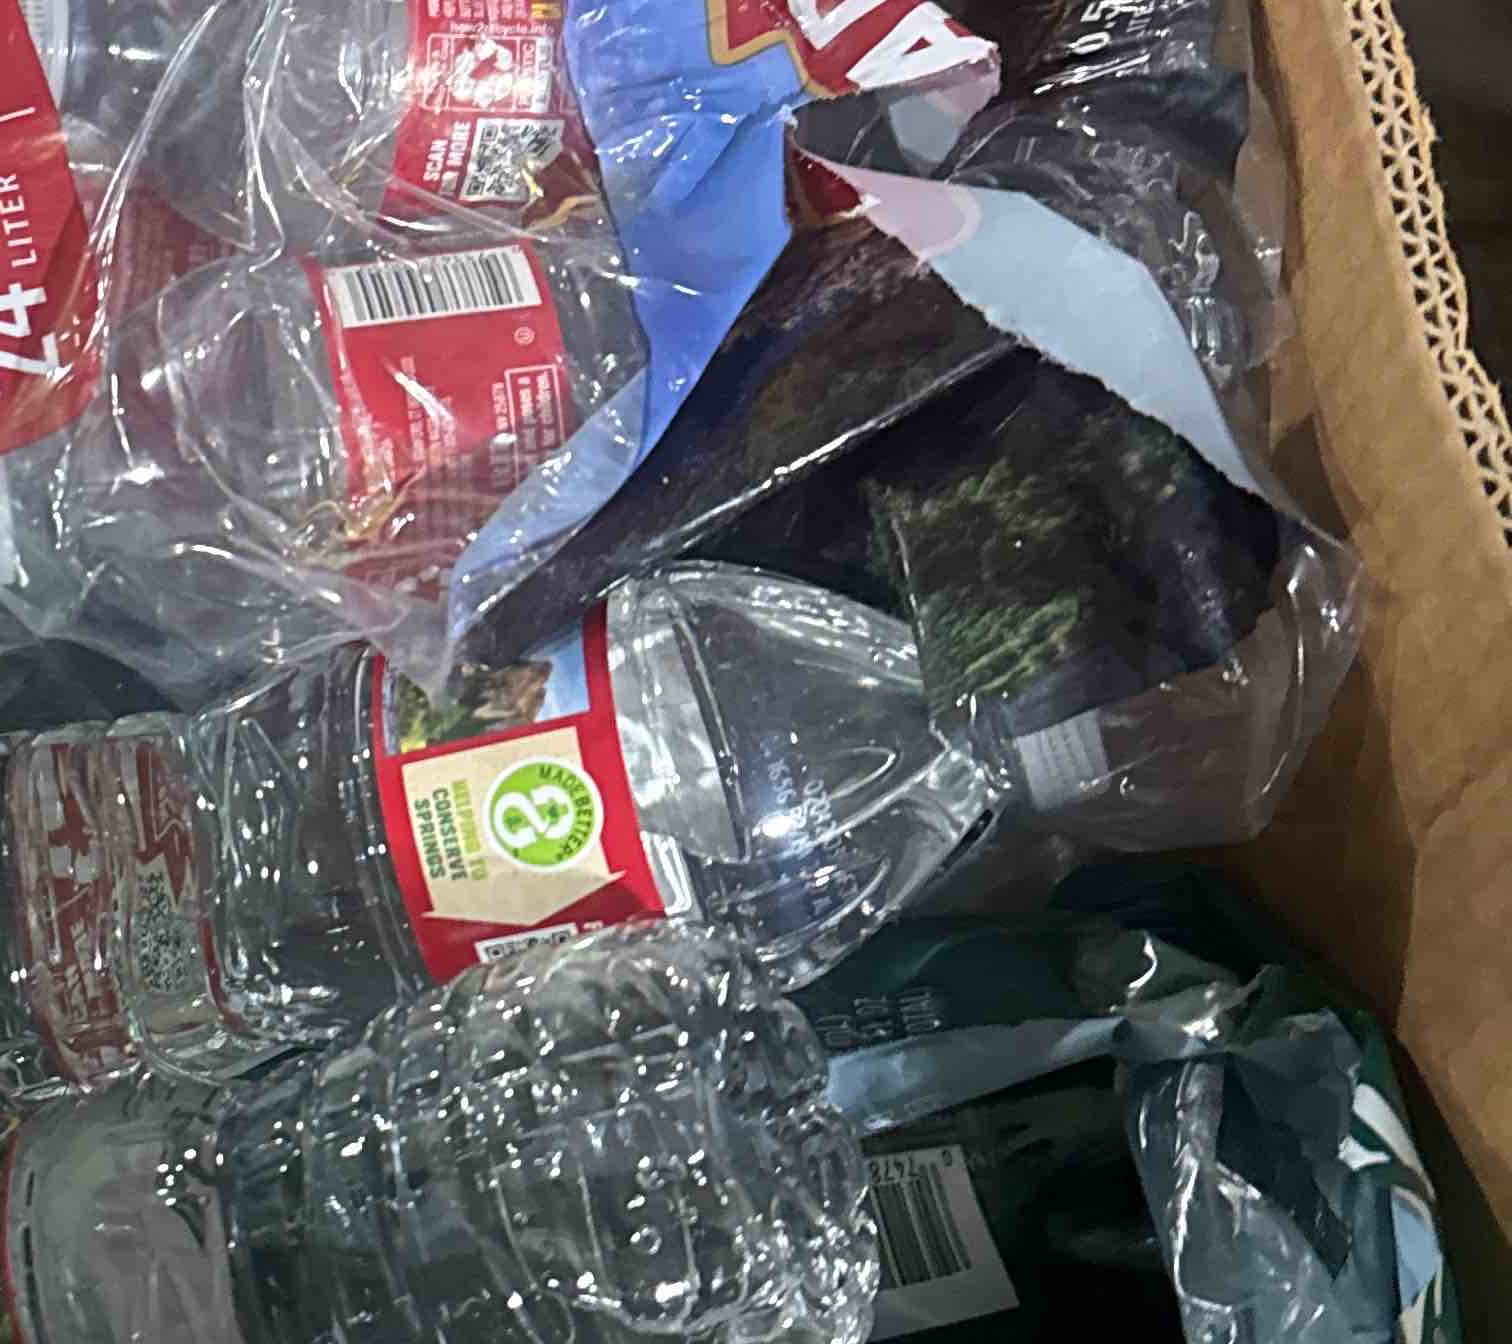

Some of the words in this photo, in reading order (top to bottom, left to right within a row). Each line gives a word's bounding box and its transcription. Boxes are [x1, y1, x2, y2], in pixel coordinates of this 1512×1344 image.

[424, 138, 448, 183] SCAN
[414, 798, 447, 880] SPRINGS
[432, 786, 468, 881] CONSERVE
